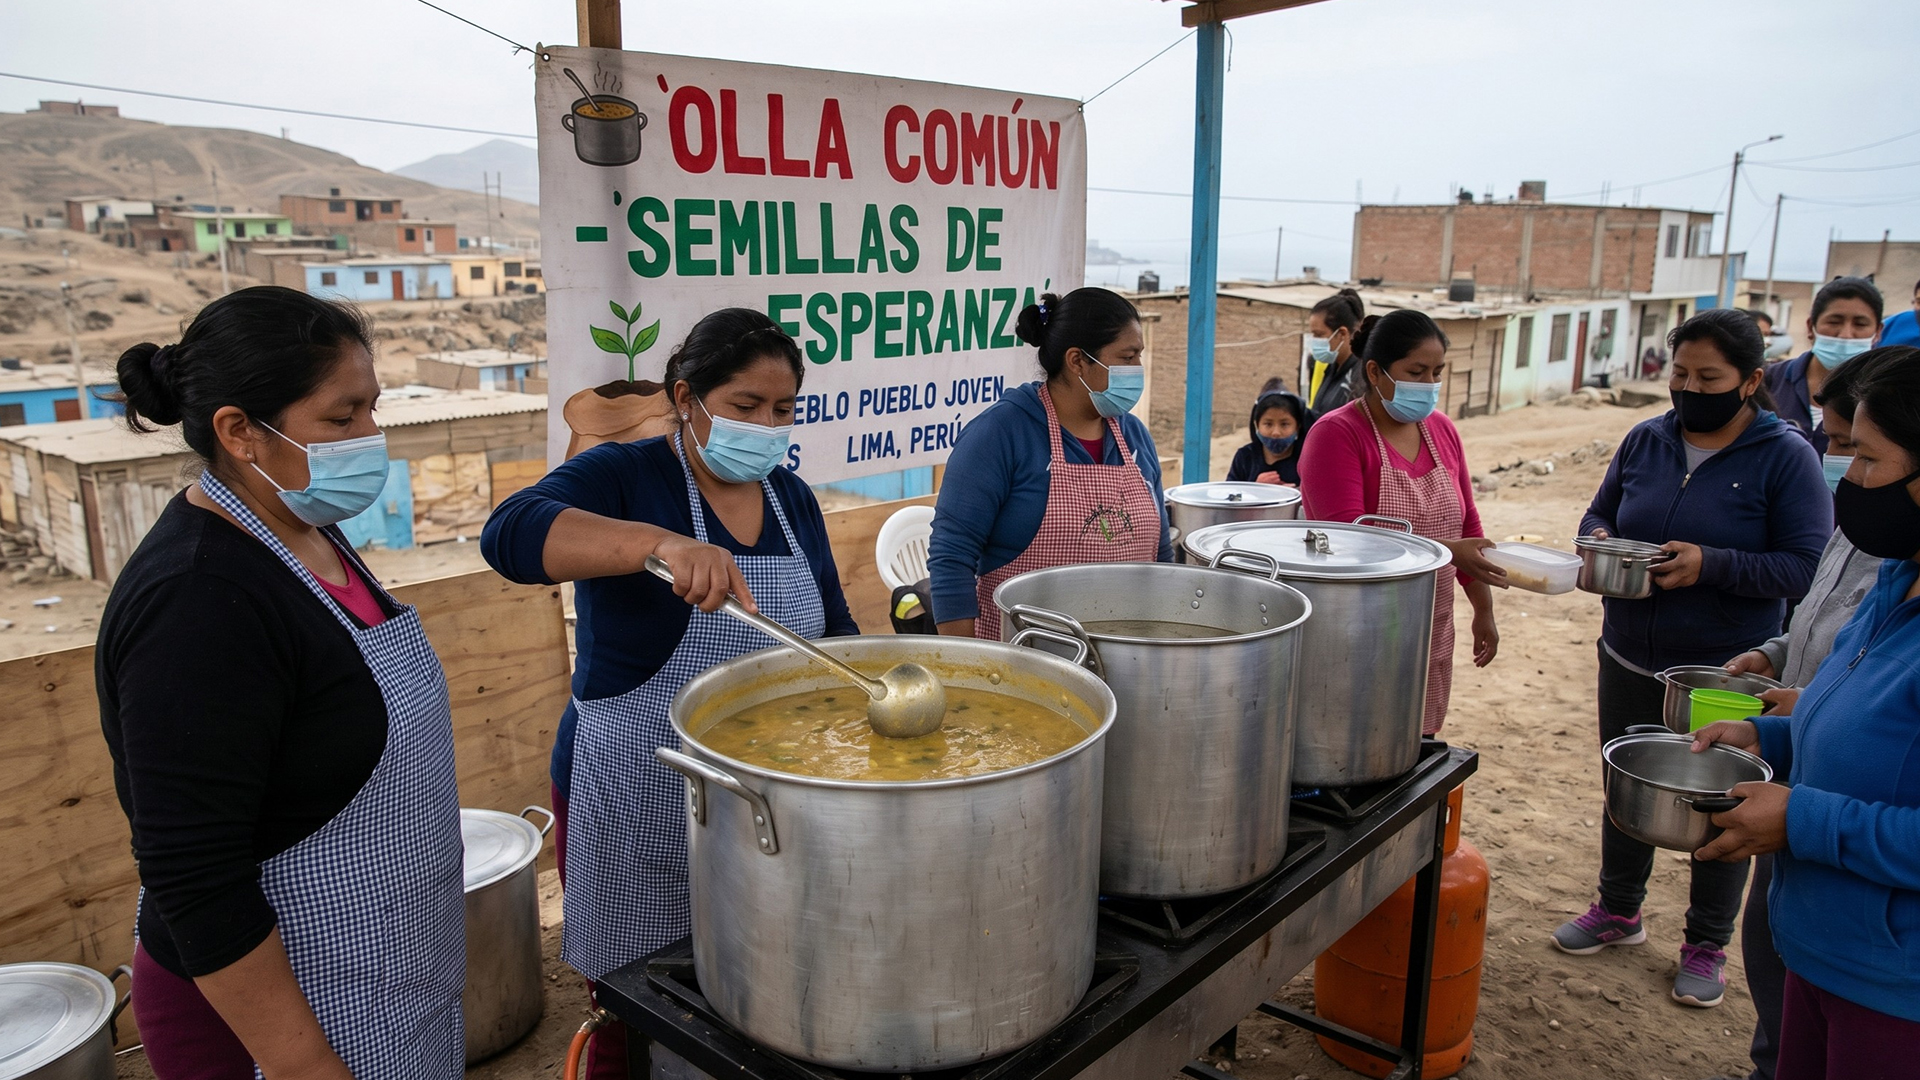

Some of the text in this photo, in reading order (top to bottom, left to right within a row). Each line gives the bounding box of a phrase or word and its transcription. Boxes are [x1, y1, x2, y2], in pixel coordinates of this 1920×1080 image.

[883, 98, 1061, 190] COMÚN
[946, 206, 1003, 272] DE
[858, 382, 937, 418] PUEBLO
[944, 375, 1004, 407] JOVEN
[846, 430, 901, 464] LIMA,
[910, 412, 962, 454] PERÚ
